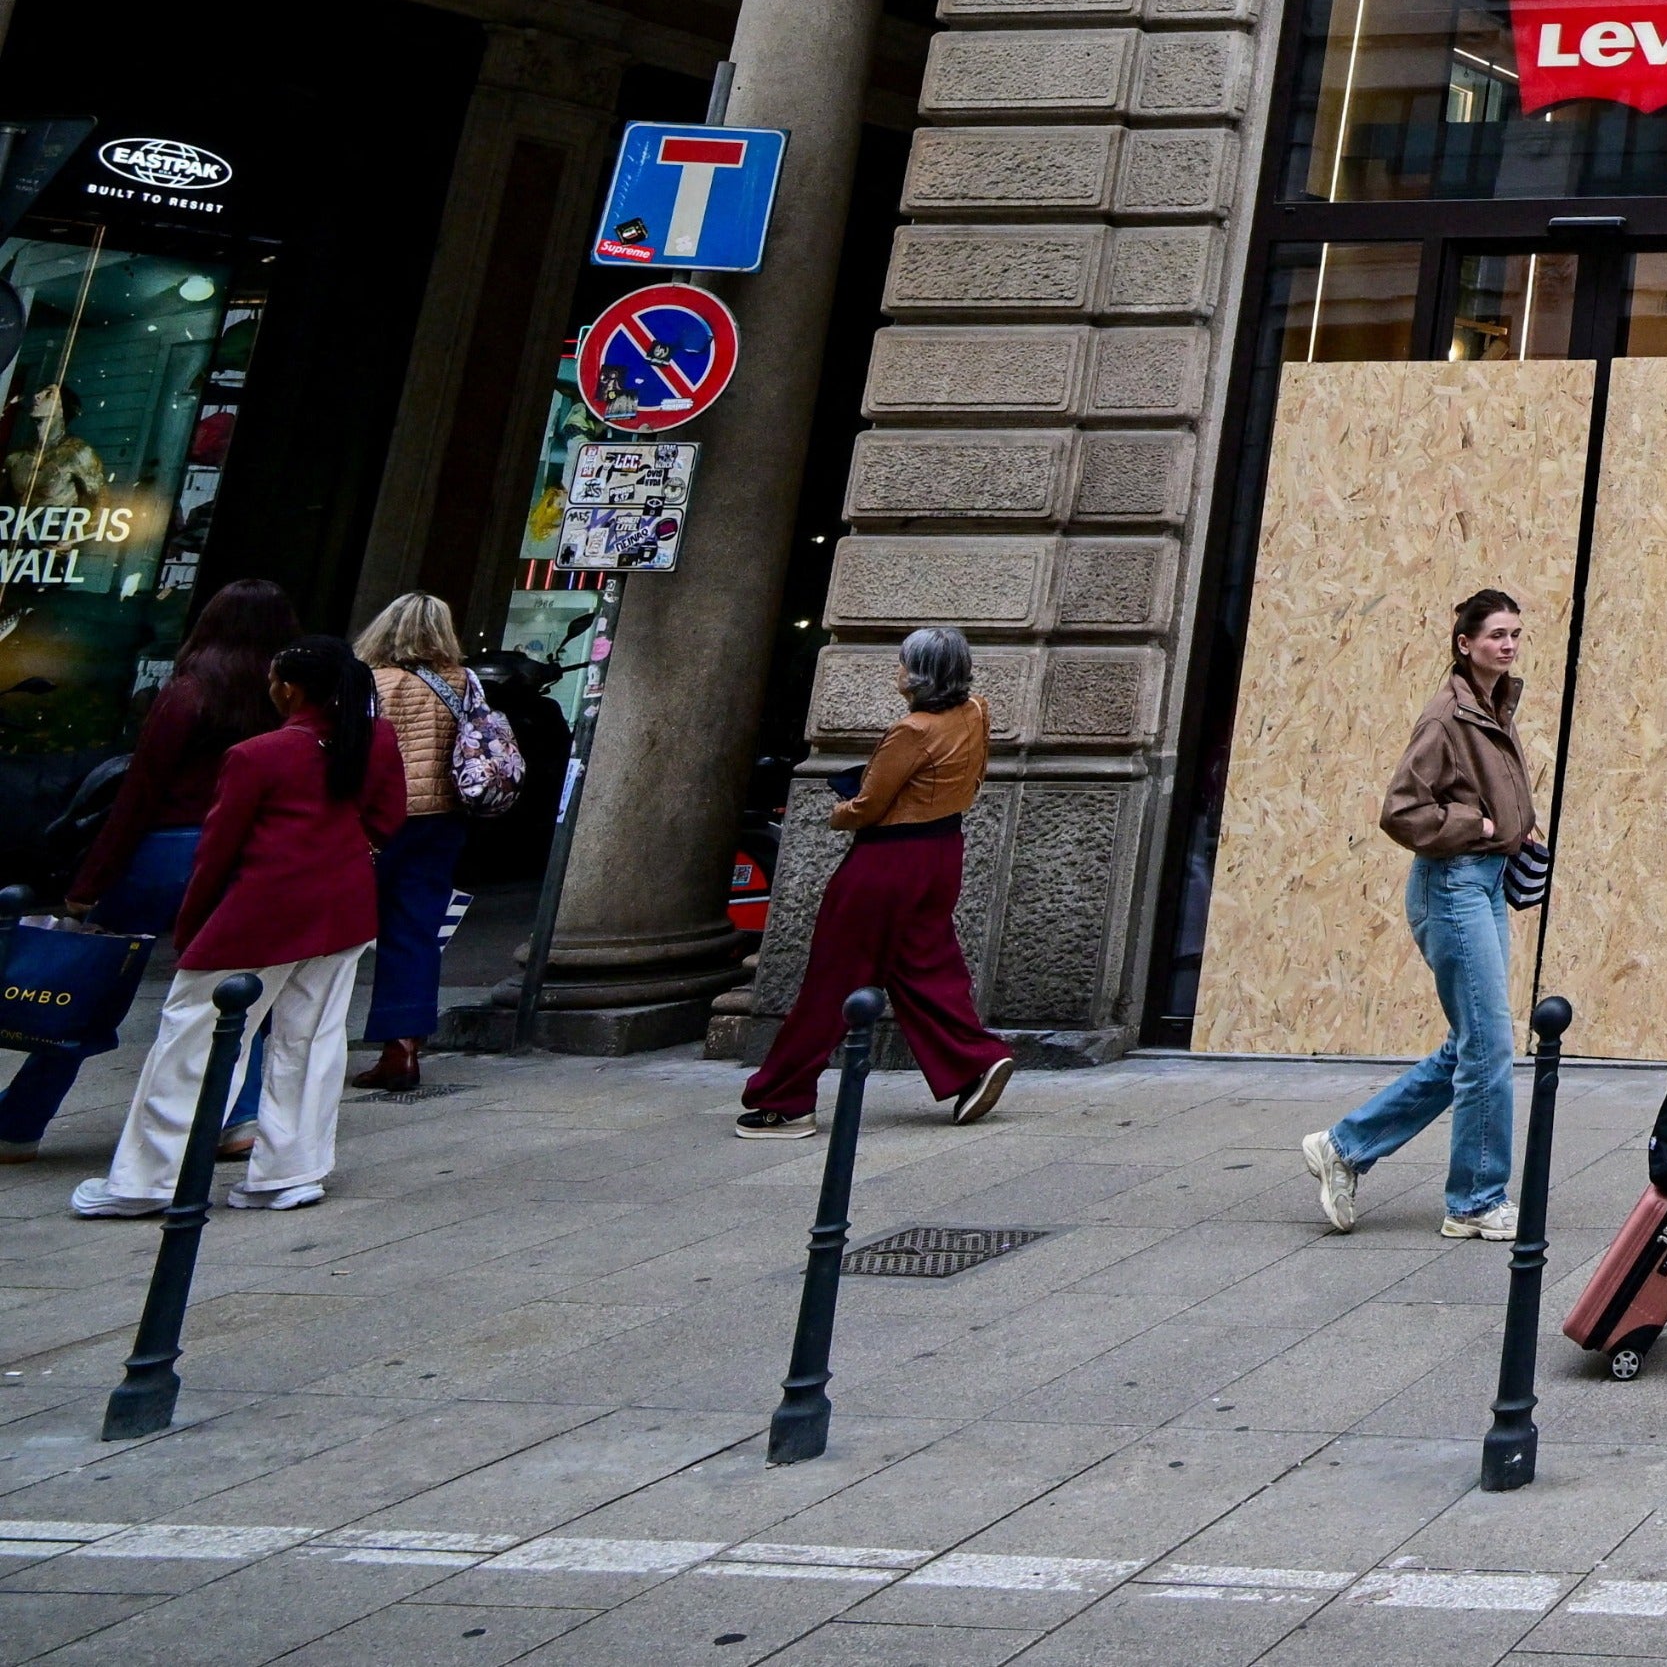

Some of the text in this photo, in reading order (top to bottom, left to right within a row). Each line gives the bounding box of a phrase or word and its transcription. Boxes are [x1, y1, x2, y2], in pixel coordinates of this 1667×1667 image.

[111, 146, 221, 180] EASTPAK
[86, 183, 224, 214] BUILT TO RESIST
[601, 241, 650, 259] Supreme
[95, 507, 133, 543] IS
